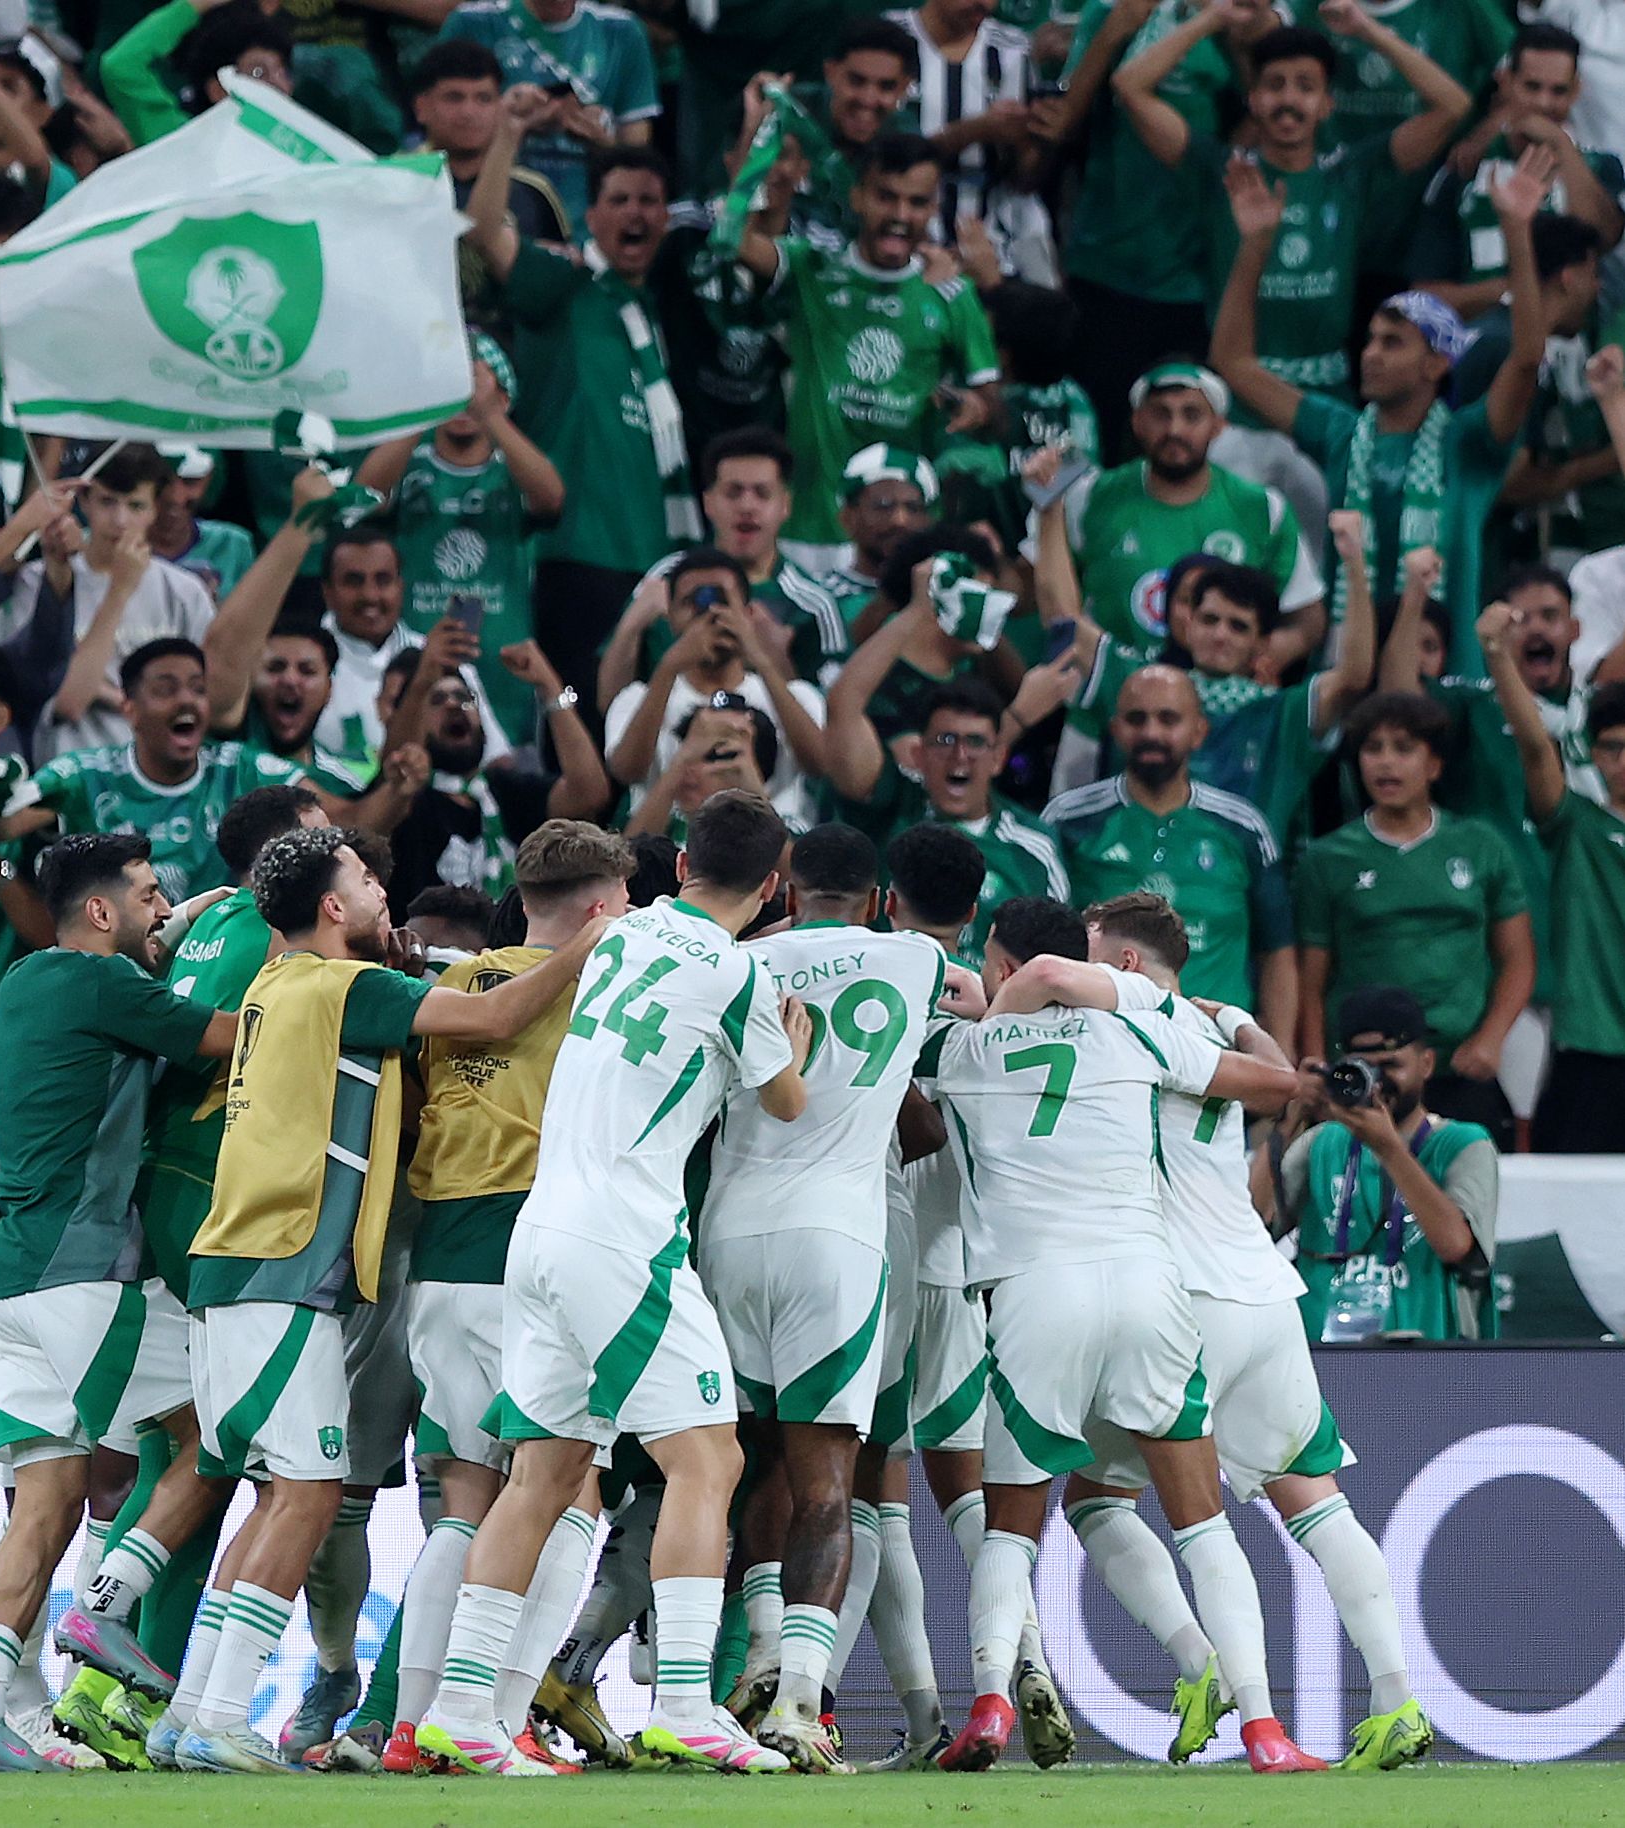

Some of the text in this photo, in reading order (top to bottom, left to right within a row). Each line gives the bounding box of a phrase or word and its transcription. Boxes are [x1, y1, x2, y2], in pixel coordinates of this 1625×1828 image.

[619, 914, 721, 969] ABRI VEIGA
[773, 952, 865, 991] TONEY
[568, 934, 682, 1067] 24
[983, 1018, 1090, 1047] MAHREZ
[1003, 1042, 1077, 1138] 7
